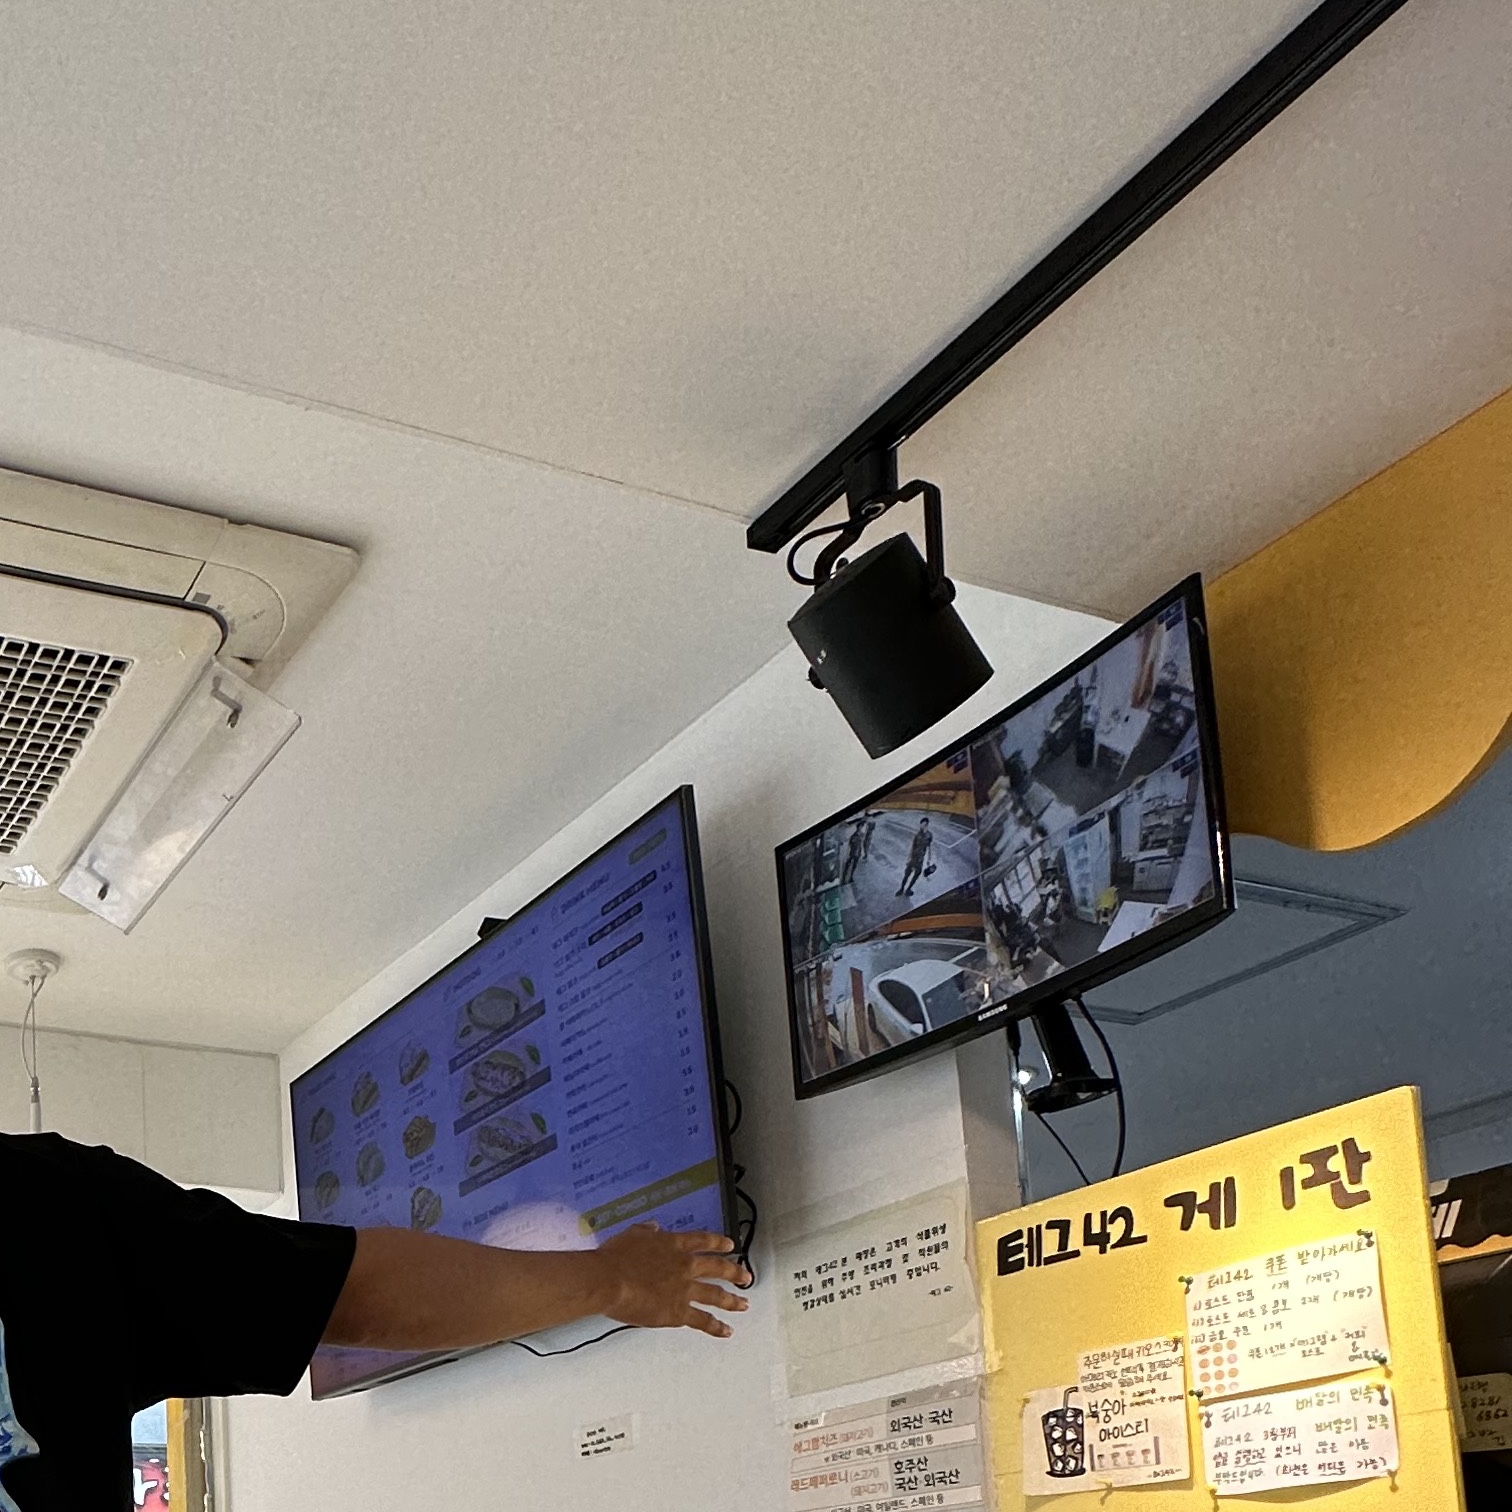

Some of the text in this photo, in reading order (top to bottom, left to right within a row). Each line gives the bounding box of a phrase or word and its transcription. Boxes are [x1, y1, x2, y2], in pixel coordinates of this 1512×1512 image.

[997, 1206, 1148, 1276] 테그42
[1086, 1398, 1127, 1423] 복숭아
[1099, 1418, 1149, 1442] 아이스티
[894, 1456, 928, 1475] 호주산
